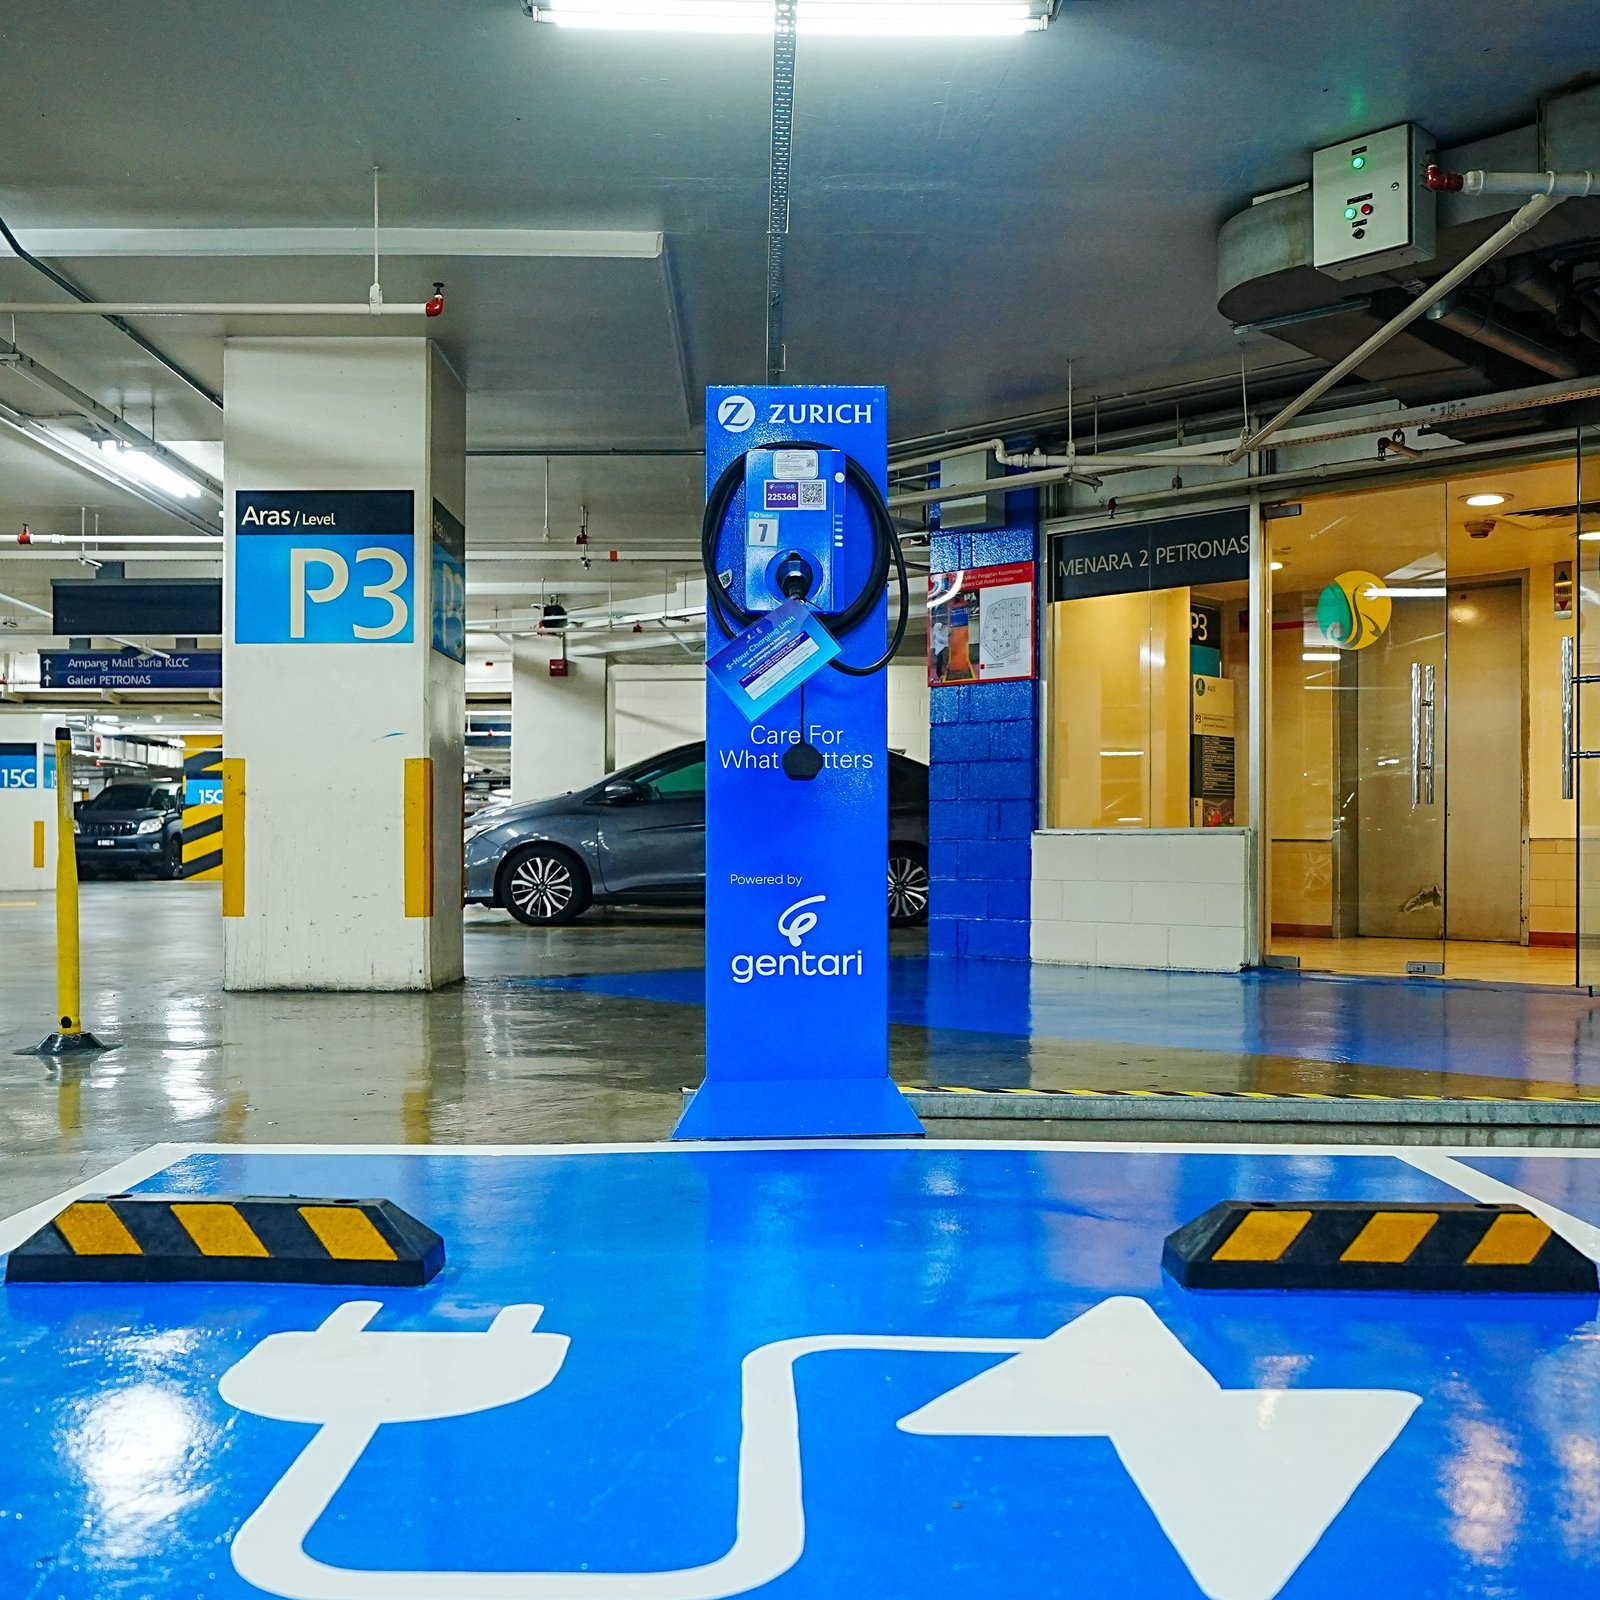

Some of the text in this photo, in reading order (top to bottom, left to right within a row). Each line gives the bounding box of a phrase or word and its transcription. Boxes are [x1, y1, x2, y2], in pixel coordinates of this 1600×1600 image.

[768, 403, 872, 425] ZURICH
[767, 493, 797, 501] 225368
[240, 505, 291, 526] Aras
[302, 512, 336, 526] Level
[758, 523, 769, 542] 7
[1058, 535, 1250, 577] MENARA 2 PETRONAS
[289, 546, 409, 641] P3
[443, 563, 464, 659] P3
[1190, 611, 1208, 641] P3
[726, 651, 749, 670] 5-Hour
[748, 628, 781, 652] Charging
[779, 615, 796, 630] Limit
[67, 658, 190, 672] Ampang Mall Suria KLCC
[67, 675, 151, 685] Galeri PETRONAS
[750, 725, 844, 745] Care For
[719, 750, 874, 769] What tters
[1, 768, 36, 788] 15C
[198, 789, 223, 804] 15C
[730, 874, 803, 887] Powered by
[731, 949, 863, 984] gentari
